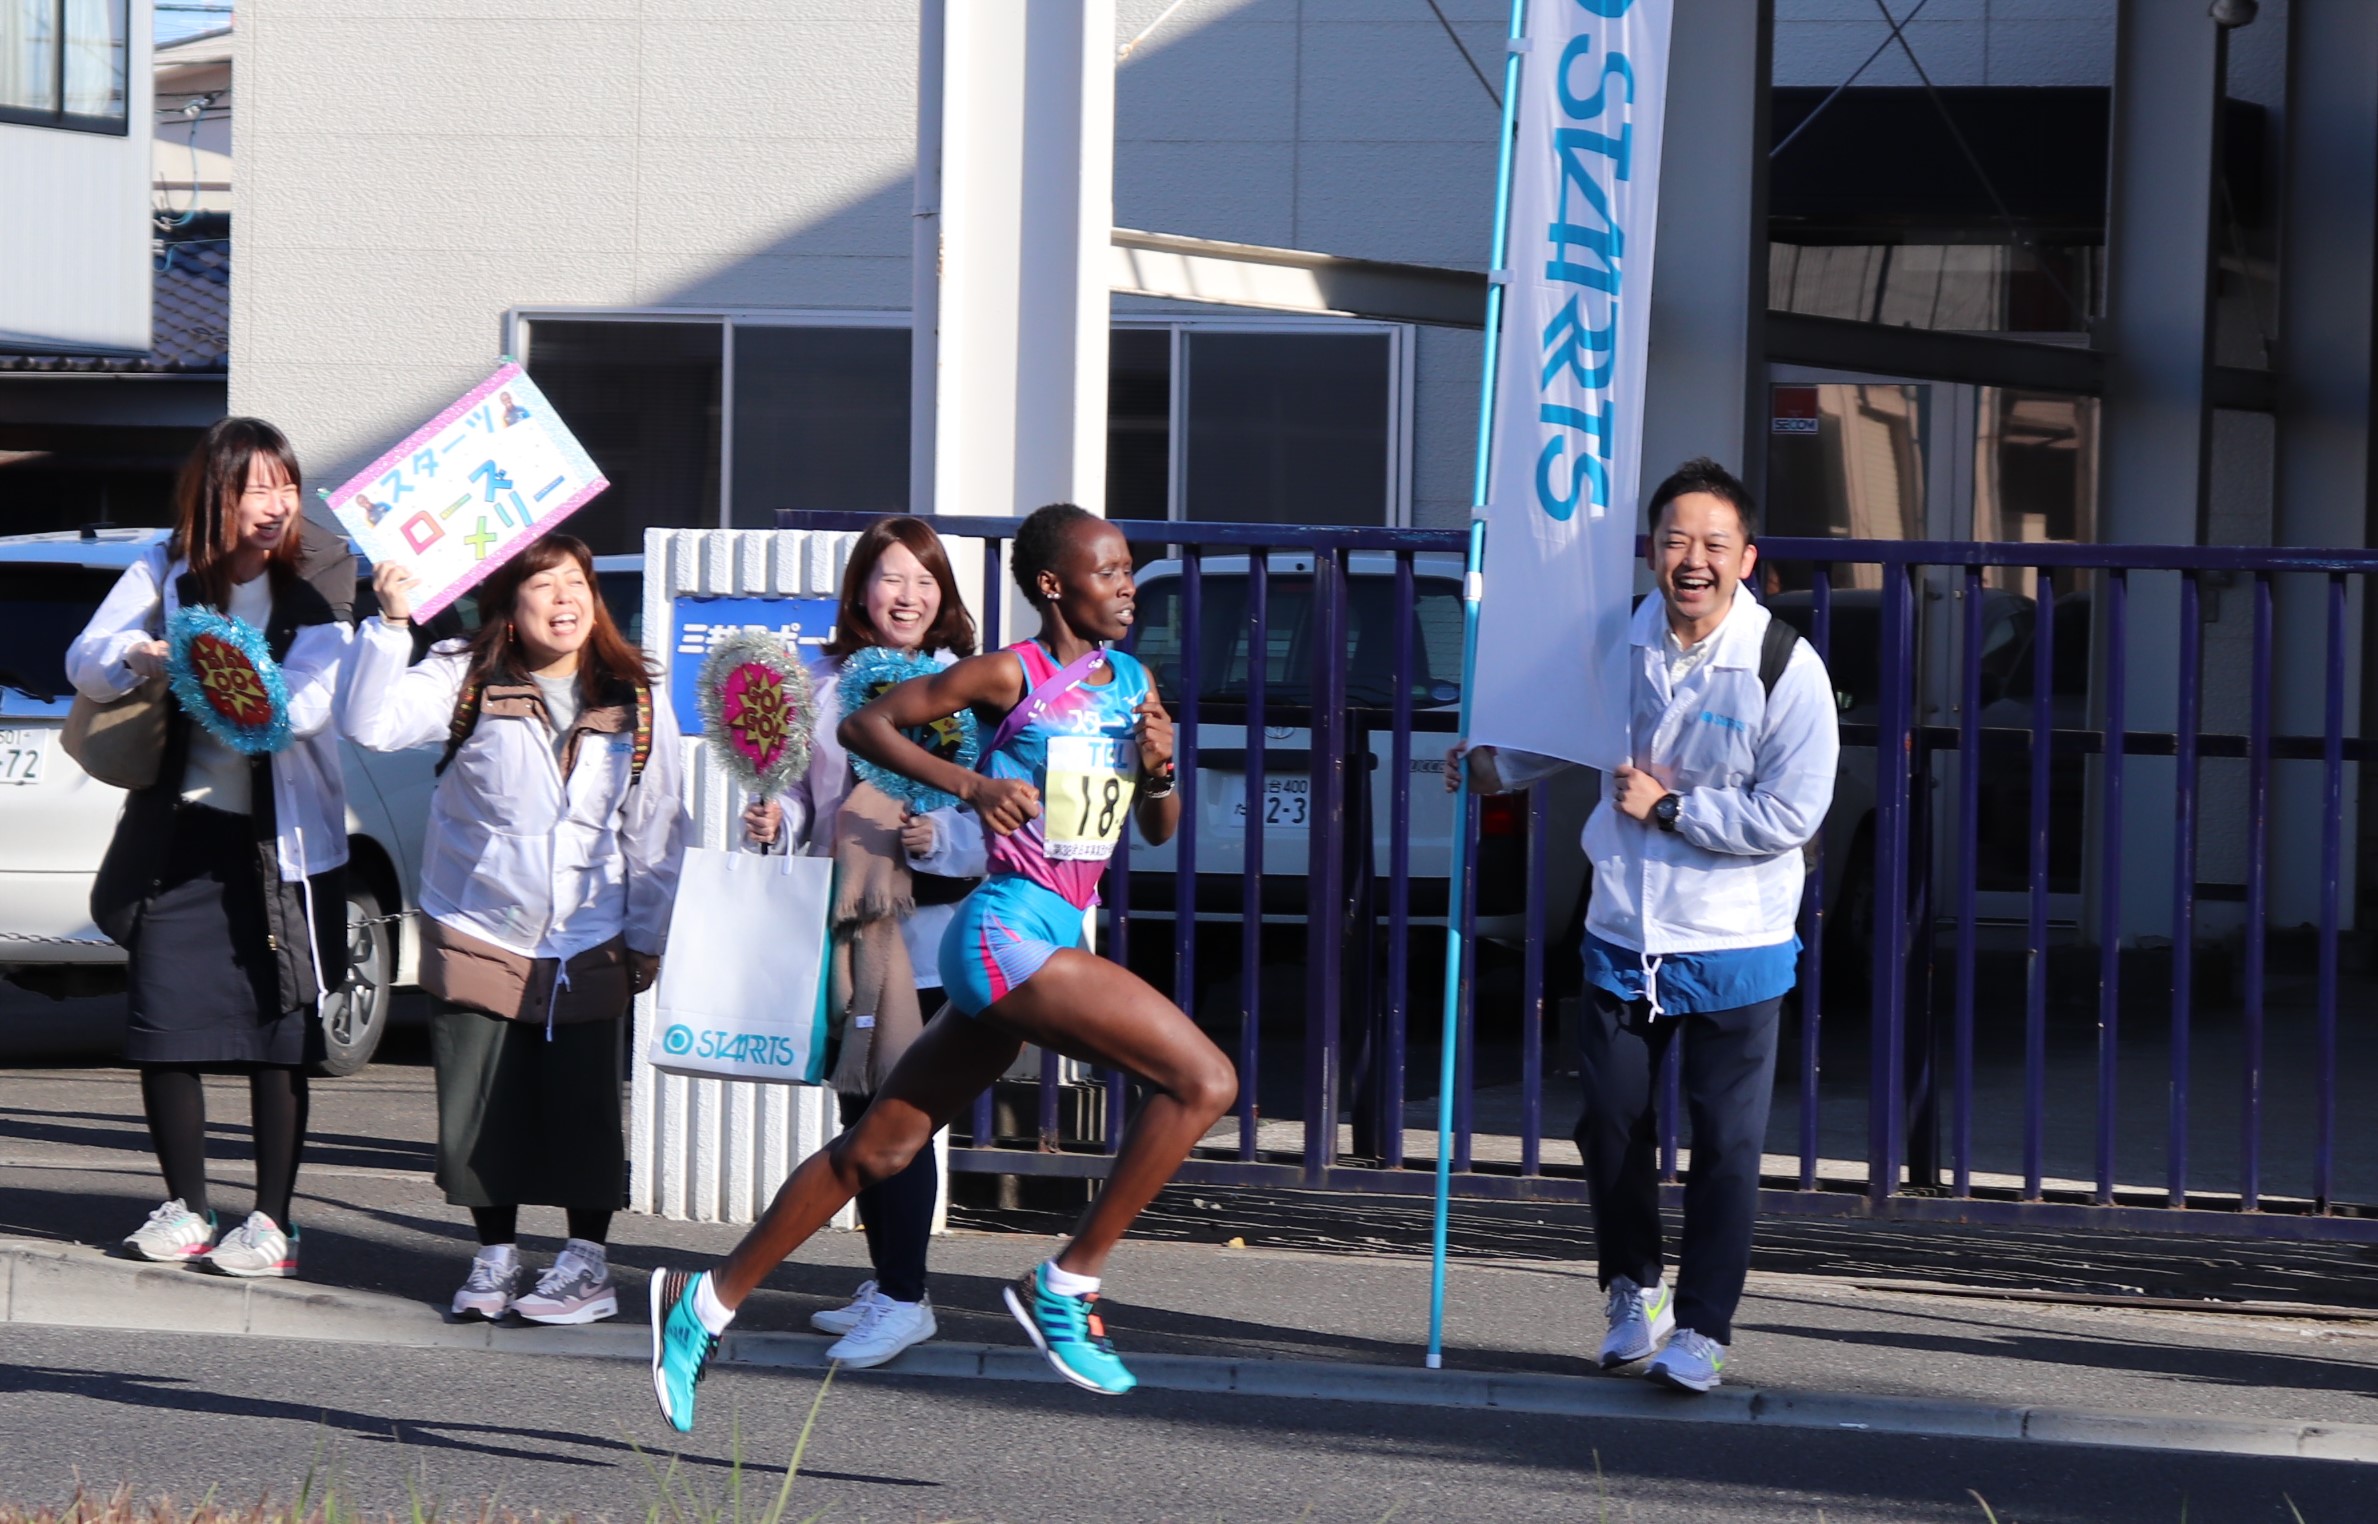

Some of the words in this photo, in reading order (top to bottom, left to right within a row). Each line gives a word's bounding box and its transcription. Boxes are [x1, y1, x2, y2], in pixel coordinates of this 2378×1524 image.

[1536, 33, 1635, 522] STARTS
[379, 405, 494, 503] スターツ
[400, 459, 513, 555] ローズ
[463, 475, 566, 560] メリー
[1077, 775, 1120, 838] 18
[696, 1029, 795, 1067] STARTS
